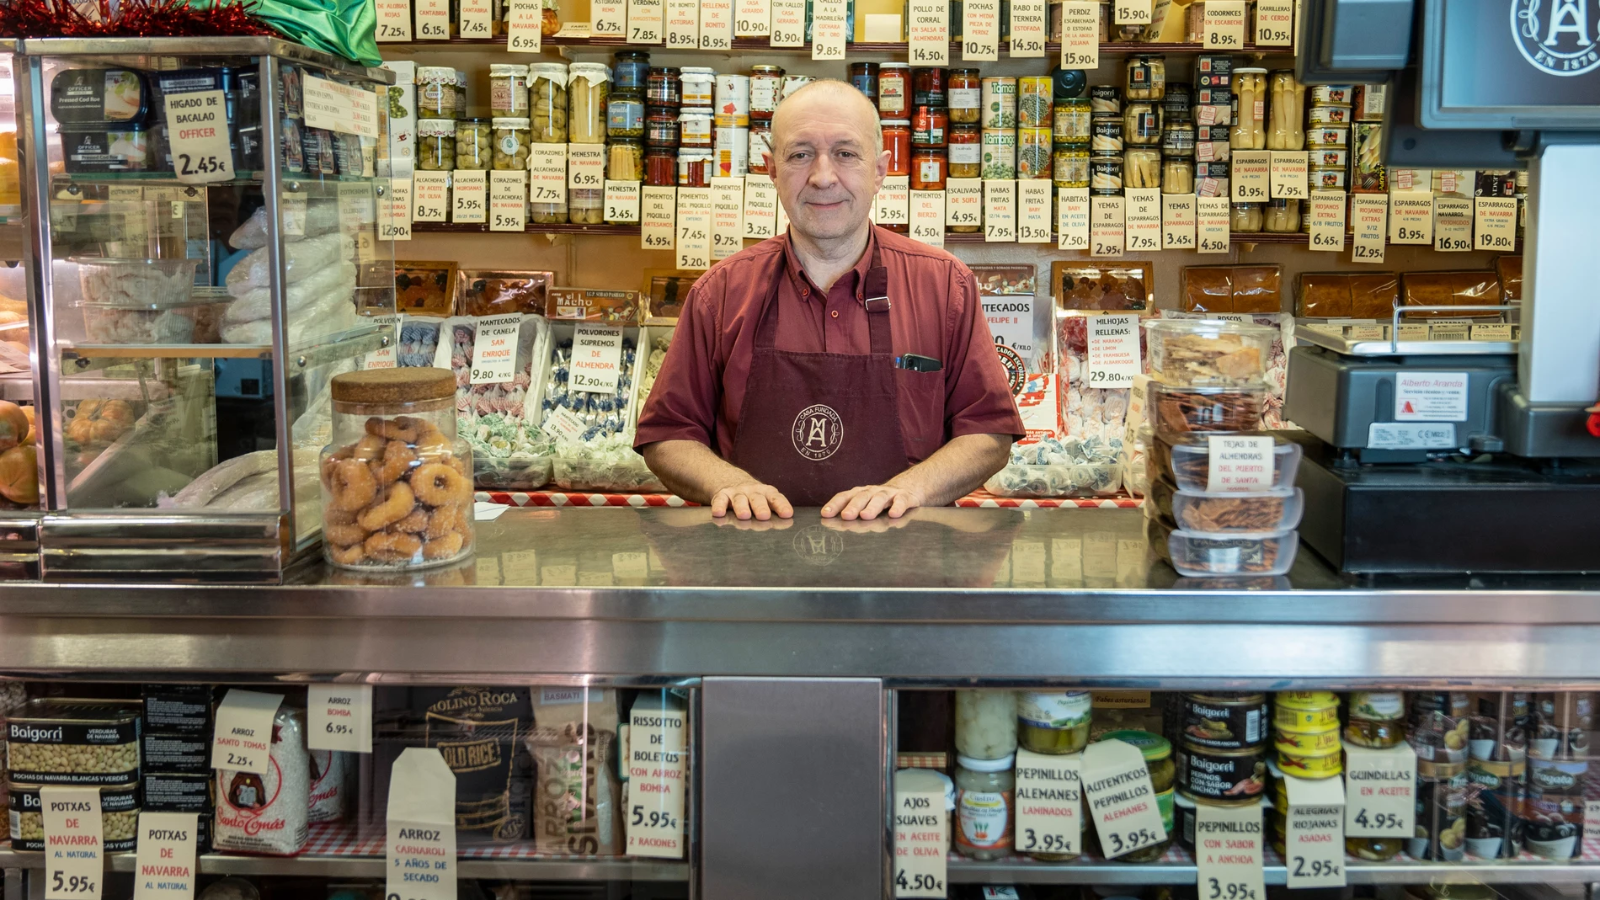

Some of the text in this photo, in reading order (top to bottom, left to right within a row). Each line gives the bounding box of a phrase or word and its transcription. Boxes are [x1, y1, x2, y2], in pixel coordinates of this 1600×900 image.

[1013, 4, 1042, 12] RABO DE
[381, 25, 405, 36] 7.25€
[422, 23, 445, 35] 6.15€
[463, 20, 487, 32] 7.45€
[596, 19, 621, 31] 6.75€
[736, 20, 768, 32] 10.90€
[632, 28, 657, 40] 7.85€
[669, 32, 695, 44] 8.95€
[774, 30, 801, 42] 8.90€
[1210, 32, 1237, 44] 8.95€
[1258, 29, 1290, 41] 10.95€
[512, 36, 538, 48] 6.95€
[702, 35, 728, 47] 8.95€
[1012, 39, 1042, 51] 14.50€
[816, 44, 842, 55] 9.85€
[965, 42, 995, 54] 10.75€
[913, 49, 944, 61] 14.50€
[1064, 53, 1095, 64] 15.90€
[1534, 50, 1598, 70] EN 1870
[170, 97, 218, 109] HIGADO DE
[176, 113, 215, 123] BACALAO
[179, 128, 215, 139] OFFICER
[179, 154, 226, 175] 2.45€
[574, 173, 599, 184] 6.95€
[536, 187, 560, 198] 7.75€
[1238, 186, 1264, 196] 8.95€
[417, 206, 441, 217] 8.75€
[609, 207, 634, 218] 3.45€
[880, 208, 905, 219] 5.95€
[951, 211, 977, 222] 4.95€
[682, 228, 706, 239] 7.45€
[747, 223, 771, 235] 3.25€
[914, 225, 940, 237] 4.50€
[987, 226, 1013, 237] 7.95€
[1020, 227, 1049, 238] 13.50€
[645, 235, 671, 246] 4.95€
[714, 234, 738, 245] 9.75€
[1061, 234, 1087, 245] 7.50€
[1131, 236, 1156, 247] 7.95€
[1167, 233, 1191, 244] 3.45€
[1313, 234, 1339, 245] 6.45€
[1439, 238, 1470, 249] 16.90€
[1480, 234, 1511, 246] 19.80€
[1096, 243, 1121, 254] 2.95€
[1355, 246, 1383, 258] 12.95€
[681, 255, 706, 266] 5.20€
[479, 316, 520, 326] MANTECADOS
[493, 328, 516, 336] CANELA
[577, 329, 620, 337] POLVORONES
[580, 339, 615, 347] SUPREMOS
[482, 349, 511, 358] ENRIQUE
[591, 350, 601, 358] DE
[575, 360, 615, 370] ALMENDRA
[800, 407, 838, 422] CASA FUNDADA
[327, 697, 352, 705] ARROZ
[544, 692, 580, 700] BASMATI
[327, 708, 352, 717] BOMBA
[1192, 704, 1230, 718] Baigorri
[633, 716, 682, 728] RISSOTTO
[10, 725, 63, 742] Baigorri
[231, 728, 255, 736] ARROZ
[217, 737, 267, 750] SANTO TOMAS
[634, 751, 679, 763] BOLETUS
[1190, 755, 1234, 773] Baigorri
[630, 768, 681, 778] CON ARROZ
[1016, 768, 1079, 781] PEPINILLOS
[1349, 770, 1411, 780] GUINDILLAS
[1086, 768, 1147, 793] AUTENTICOS
[640, 783, 671, 793] BOMBA
[1360, 787, 1411, 796] EN ACEITE
[1016, 788, 1079, 801] ALEMANES
[1093, 785, 1149, 809] PEPINILLOS
[51, 802, 91, 812] POTXAS
[903, 798, 930, 808] AJOS
[632, 805, 677, 828] 5.95€
[1022, 807, 1073, 816] LAMINADOS
[1102, 803, 1148, 822] ALEMANES
[216, 806, 286, 836] Santo Tomás
[896, 816, 938, 825] SUAVES
[1354, 808, 1404, 828] 4.95€
[1198, 821, 1260, 833] PEPINILLOS
[1292, 820, 1338, 830] RIOJANAS
[49, 835, 98, 845] NAVARRA
[148, 830, 188, 841] POTXAS
[398, 828, 441, 841] ARROZ
[1024, 828, 1071, 851] 3.95€
[1108, 828, 1157, 852] 3.95€
[1298, 834, 1332, 842] ASADAS
[629, 837, 677, 848] 2 RACIONES
[1204, 839, 1254, 849] CON SABOR
[395, 845, 445, 856] CARNAROLI
[896, 847, 939, 856] DE OLIVA
[404, 858, 430, 869] AÑOS
[434, 862, 447, 870] DE
[1206, 855, 1253, 864] A ANCHOA
[141, 865, 190, 877] NAVARRA
[1293, 856, 1340, 876] 2.95€
[52, 870, 95, 893] 5.95€
[403, 873, 439, 882] SECADO
[896, 869, 943, 890] 4.50€
[1208, 877, 1256, 900] 3.95€
